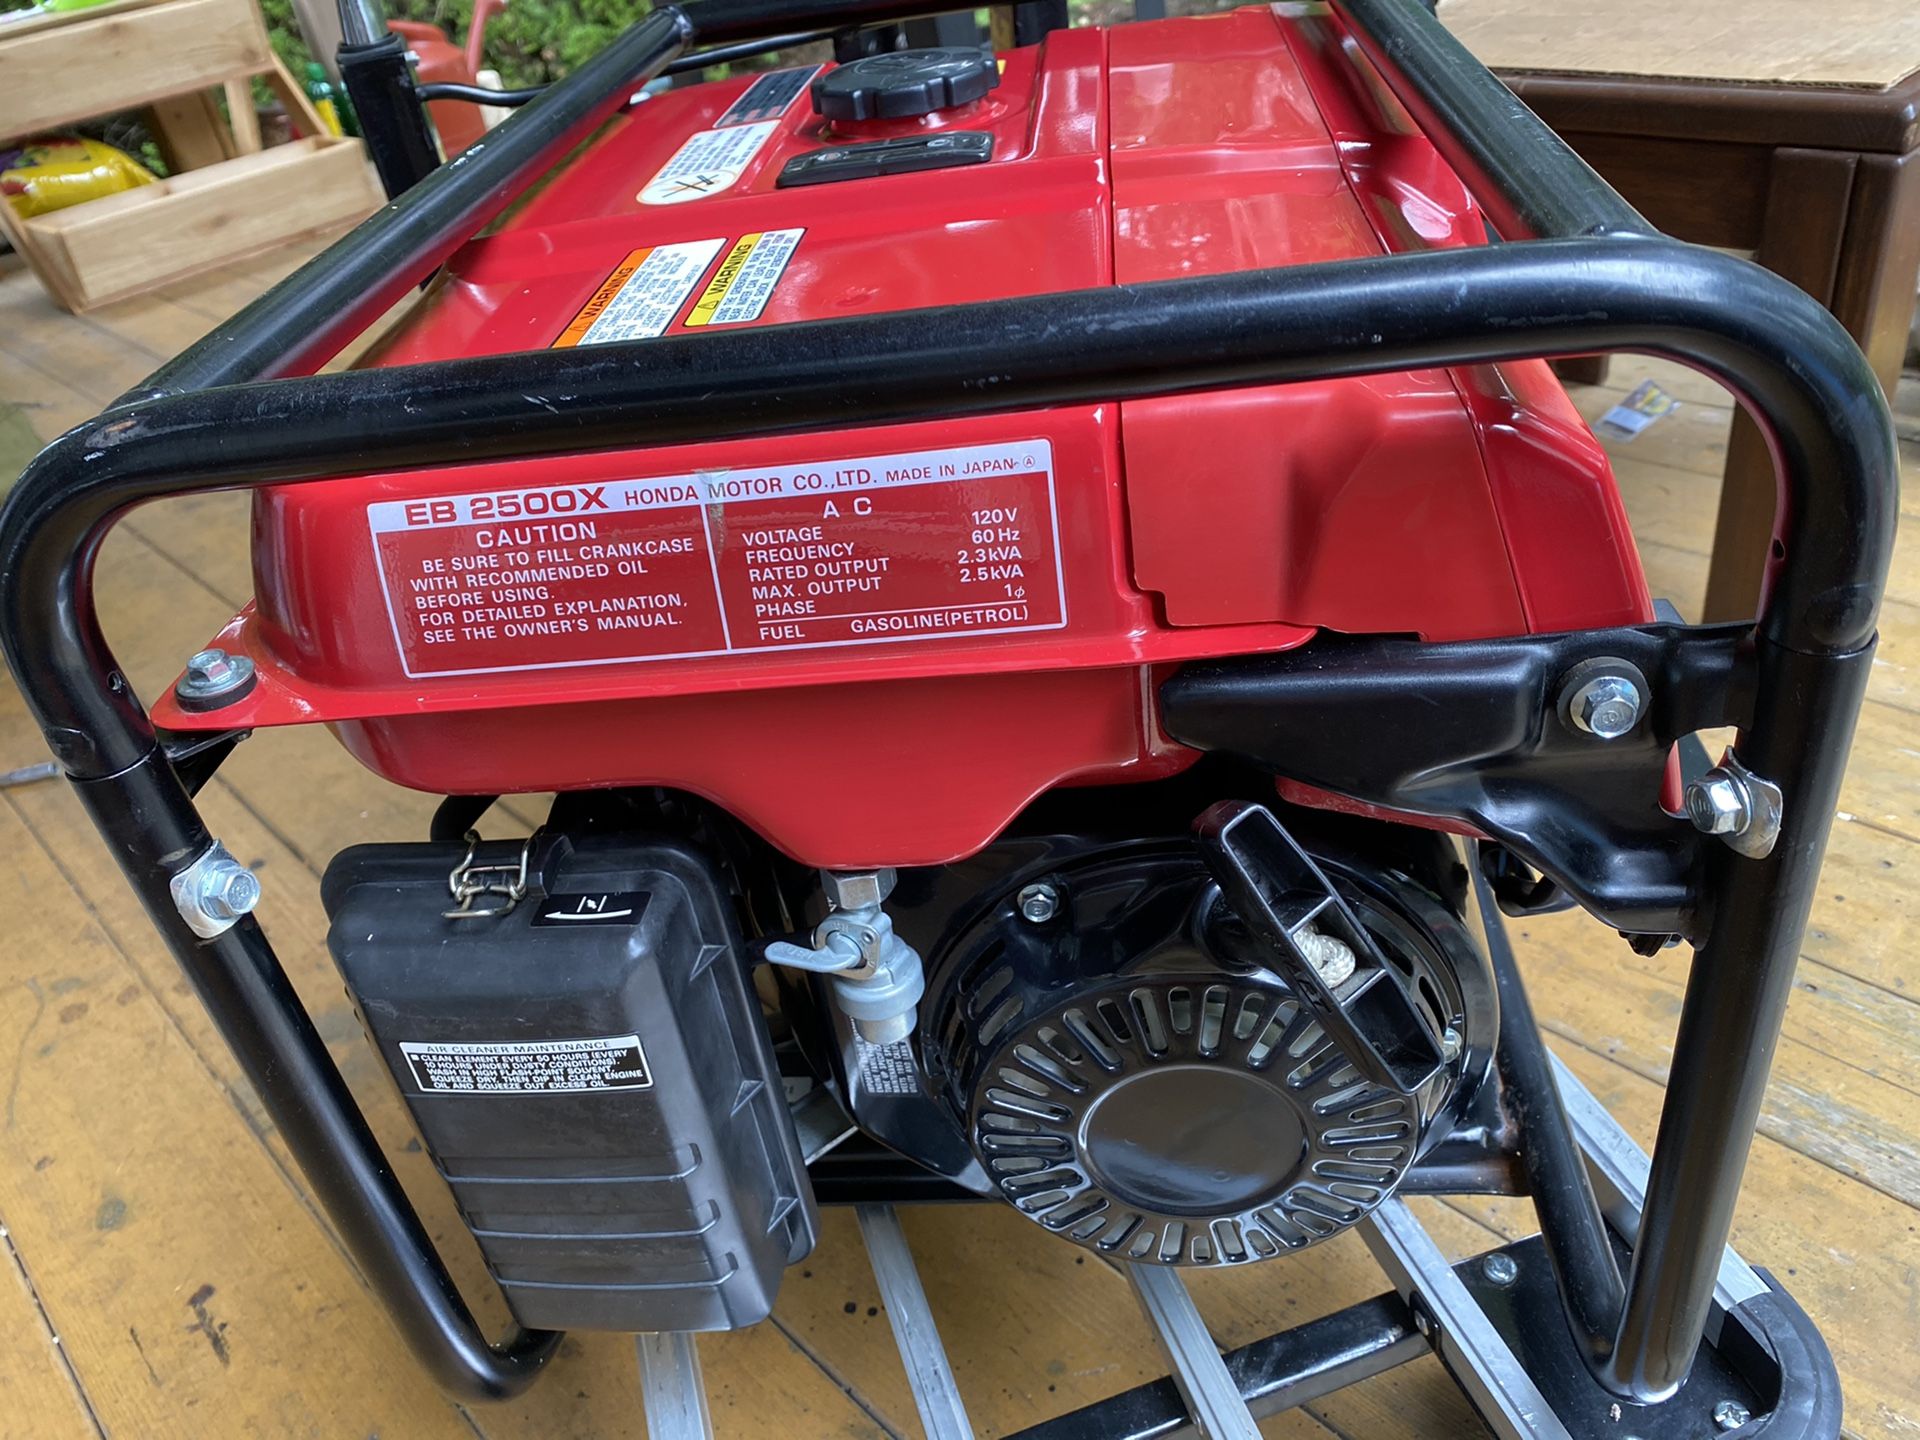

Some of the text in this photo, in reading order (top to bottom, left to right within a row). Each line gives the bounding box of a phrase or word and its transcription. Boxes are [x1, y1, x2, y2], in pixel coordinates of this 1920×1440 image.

[706, 243, 752, 295] WARNING
[579, 266, 635, 318] WARNING
[404, 500, 457, 526] EB
[469, 487, 609, 520] 2500X
[624, 485, 699, 506] HONDA
[708, 478, 782, 499] MOTOR
[886, 466, 932, 483] MADE
[939, 464, 955, 477] IN
[476, 521, 597, 549] CAUTION
[741, 526, 823, 547] VOLTAGE
[745, 527, 1021, 565] FREQUENCY 60 Hz
[422, 537, 694, 574] BE SURE TO FILL CRANKCASE
[410, 560, 648, 592] WITH RECOMMENDED OIL
[749, 565, 809, 582] RATED
[815, 558, 890, 578] OUTPUT
[415, 586, 555, 610] BEFORE USING.
[751, 584, 801, 600] MAX.
[808, 577, 882, 596] OUTPUT
[419, 612, 455, 627] FOR
[463, 605, 546, 623] DETAILED
[755, 601, 816, 618] PHASE
[423, 611, 682, 644] SEE THE OWNER'S MANUAL.
[759, 605, 1029, 641] FUEL GASOLINE(PETROL)
[420, 1054, 452, 1062] CLEAN
[501, 1055, 533, 1063] EVERY
[551, 1052, 590, 1061] HOURS
[427, 1041, 611, 1054] AIR CLEANER MAINTENANCE
[424, 1061, 436, 1069] 10
[437, 1062, 473, 1070] HOURS
[474, 1062, 510, 1070] UNDER
[512, 1062, 546, 1070] DUSTY
[426, 1068, 457, 1076] WASH
[430, 1075, 474, 1083] SQUEEZE
[501, 1075, 529, 1083] THEN
[532, 1075, 550, 1083] DIP
[553, 1074, 564, 1082] IN
[567, 1073, 601, 1081] CLEAN
[604, 1069, 644, 1080] ENGINE
[477, 1082, 522, 1090] SQUEEZE
[524, 1082, 545, 1090] OUT
[548, 1081, 587, 1089] EXCESS
